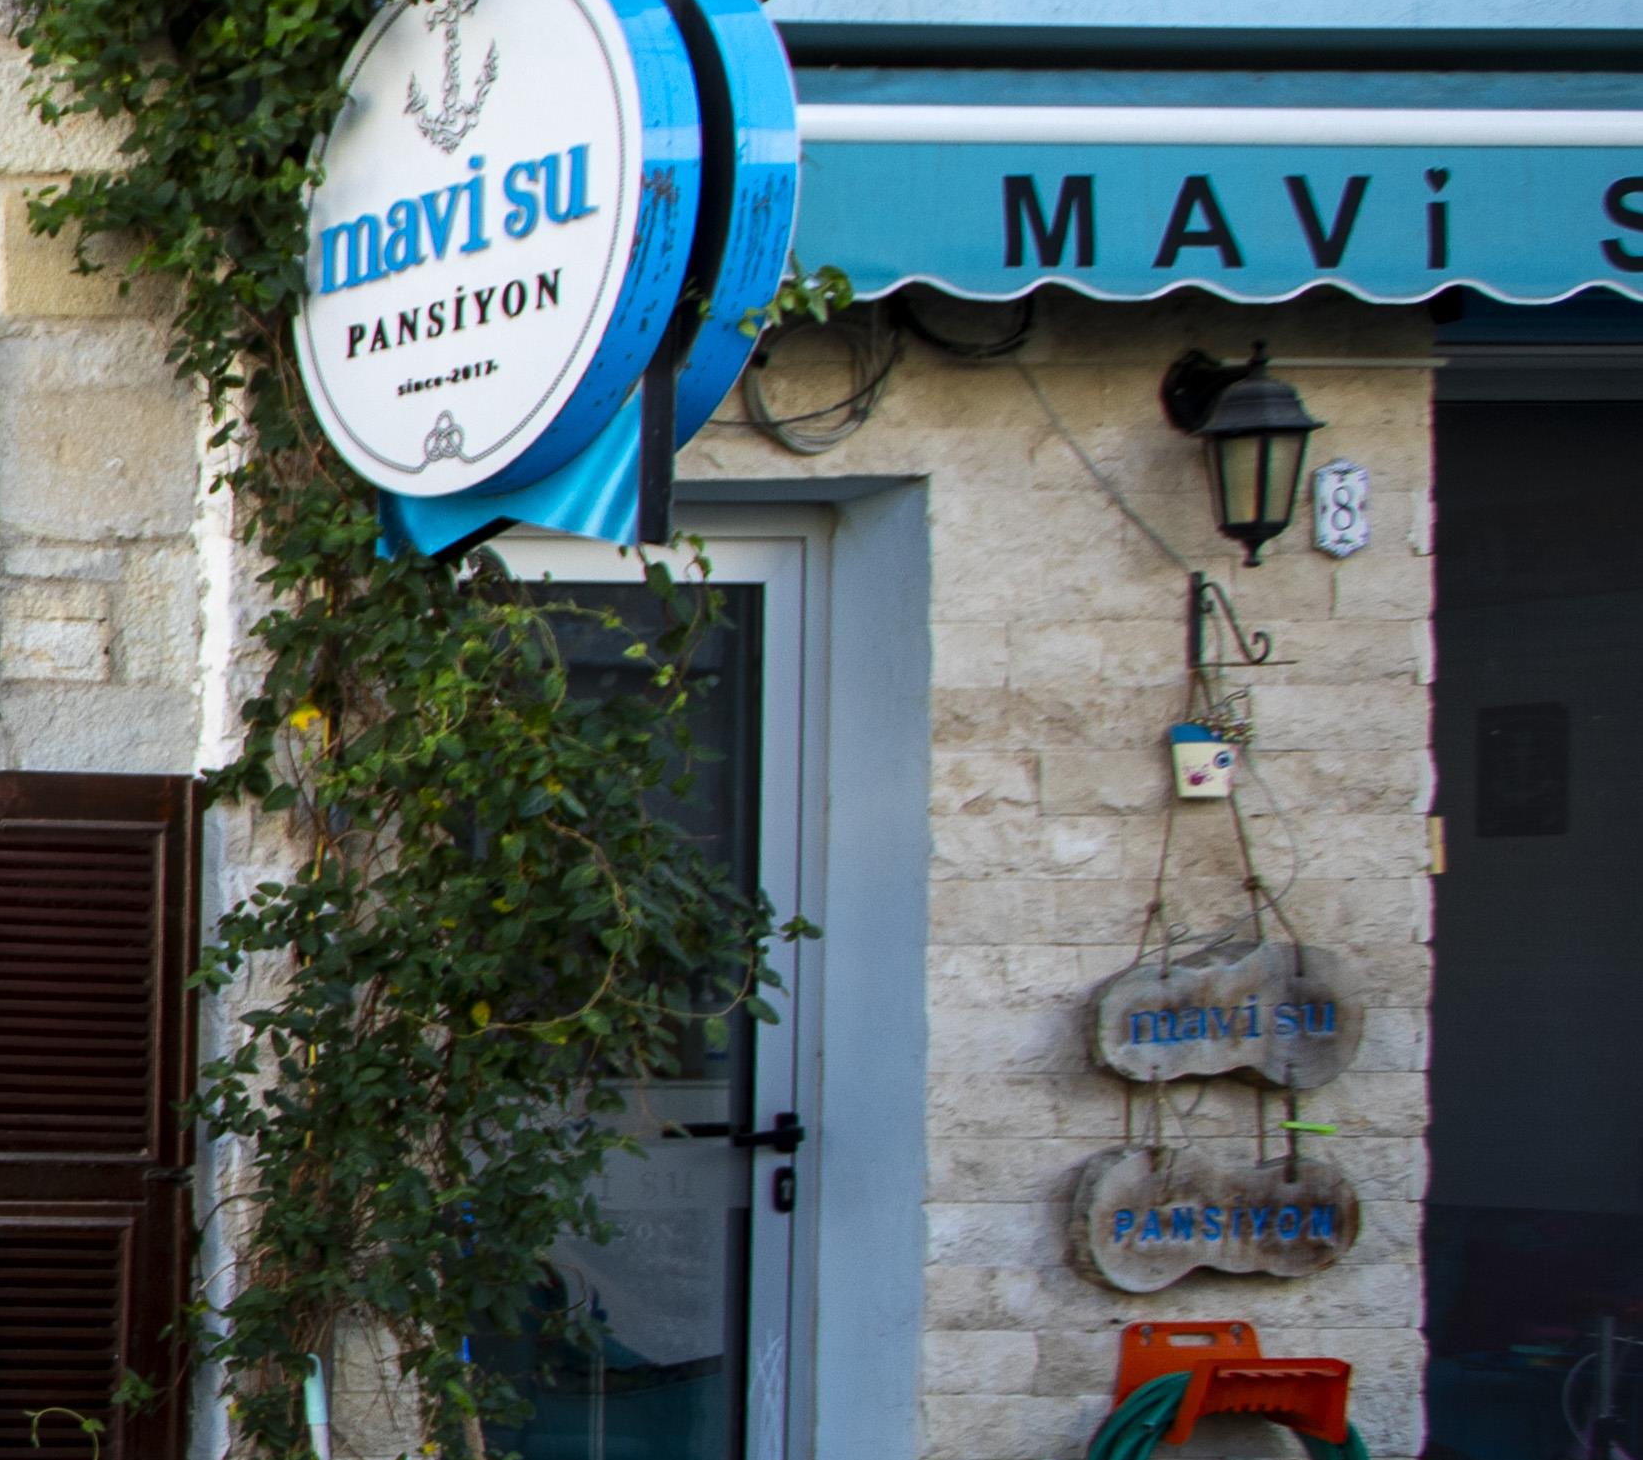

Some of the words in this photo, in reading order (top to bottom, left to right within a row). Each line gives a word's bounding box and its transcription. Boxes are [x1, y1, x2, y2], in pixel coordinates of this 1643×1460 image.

[320, 155, 491, 296] mavi
[502, 142, 600, 240] su
[345, 267, 564, 360] PANSİYON
[1330, 485, 1357, 531] 8
[1130, 994, 1263, 1046] mavi
[1274, 1001, 1337, 1036] su
